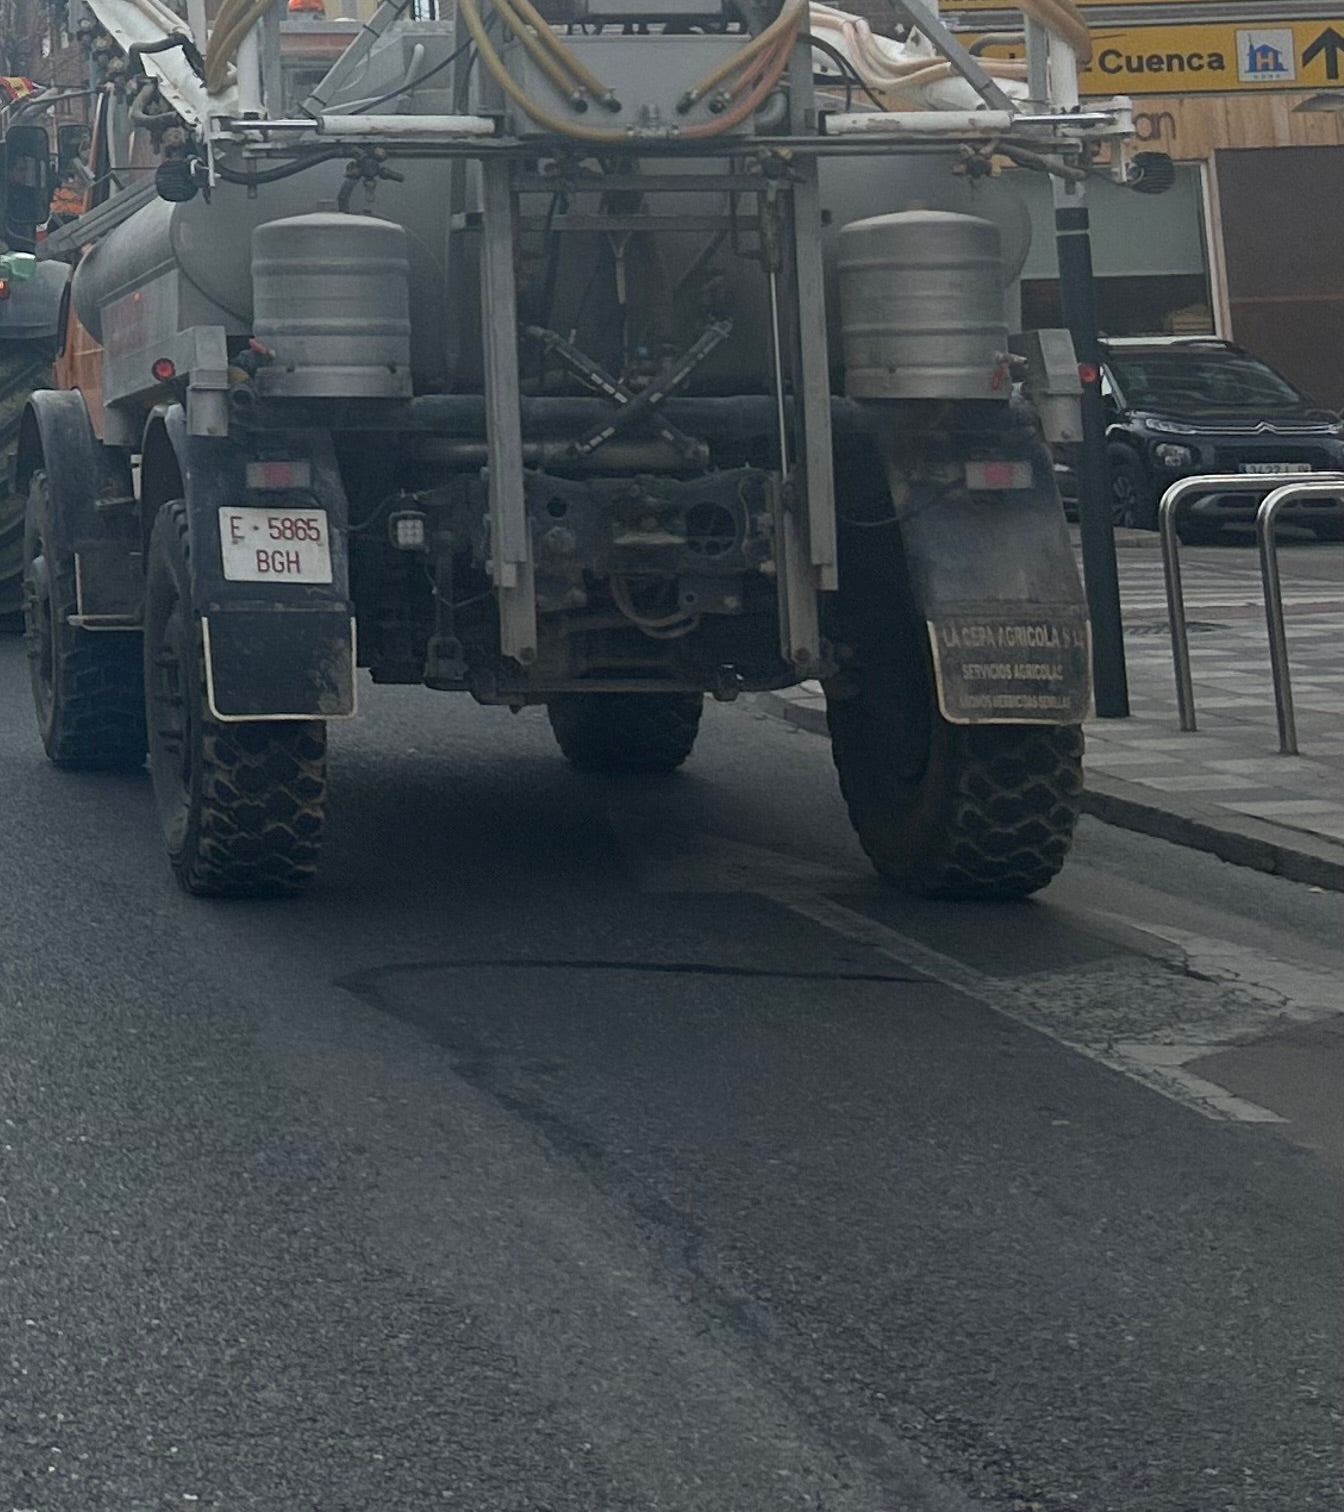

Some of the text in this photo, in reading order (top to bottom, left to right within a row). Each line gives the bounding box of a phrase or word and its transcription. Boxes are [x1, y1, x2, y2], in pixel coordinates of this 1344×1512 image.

[1098, 48, 1225, 74] Cuenca
[267, 516, 321, 541] 5865
[256, 548, 301, 574] BGH
[998, 624, 1060, 649] AGRICOLA
